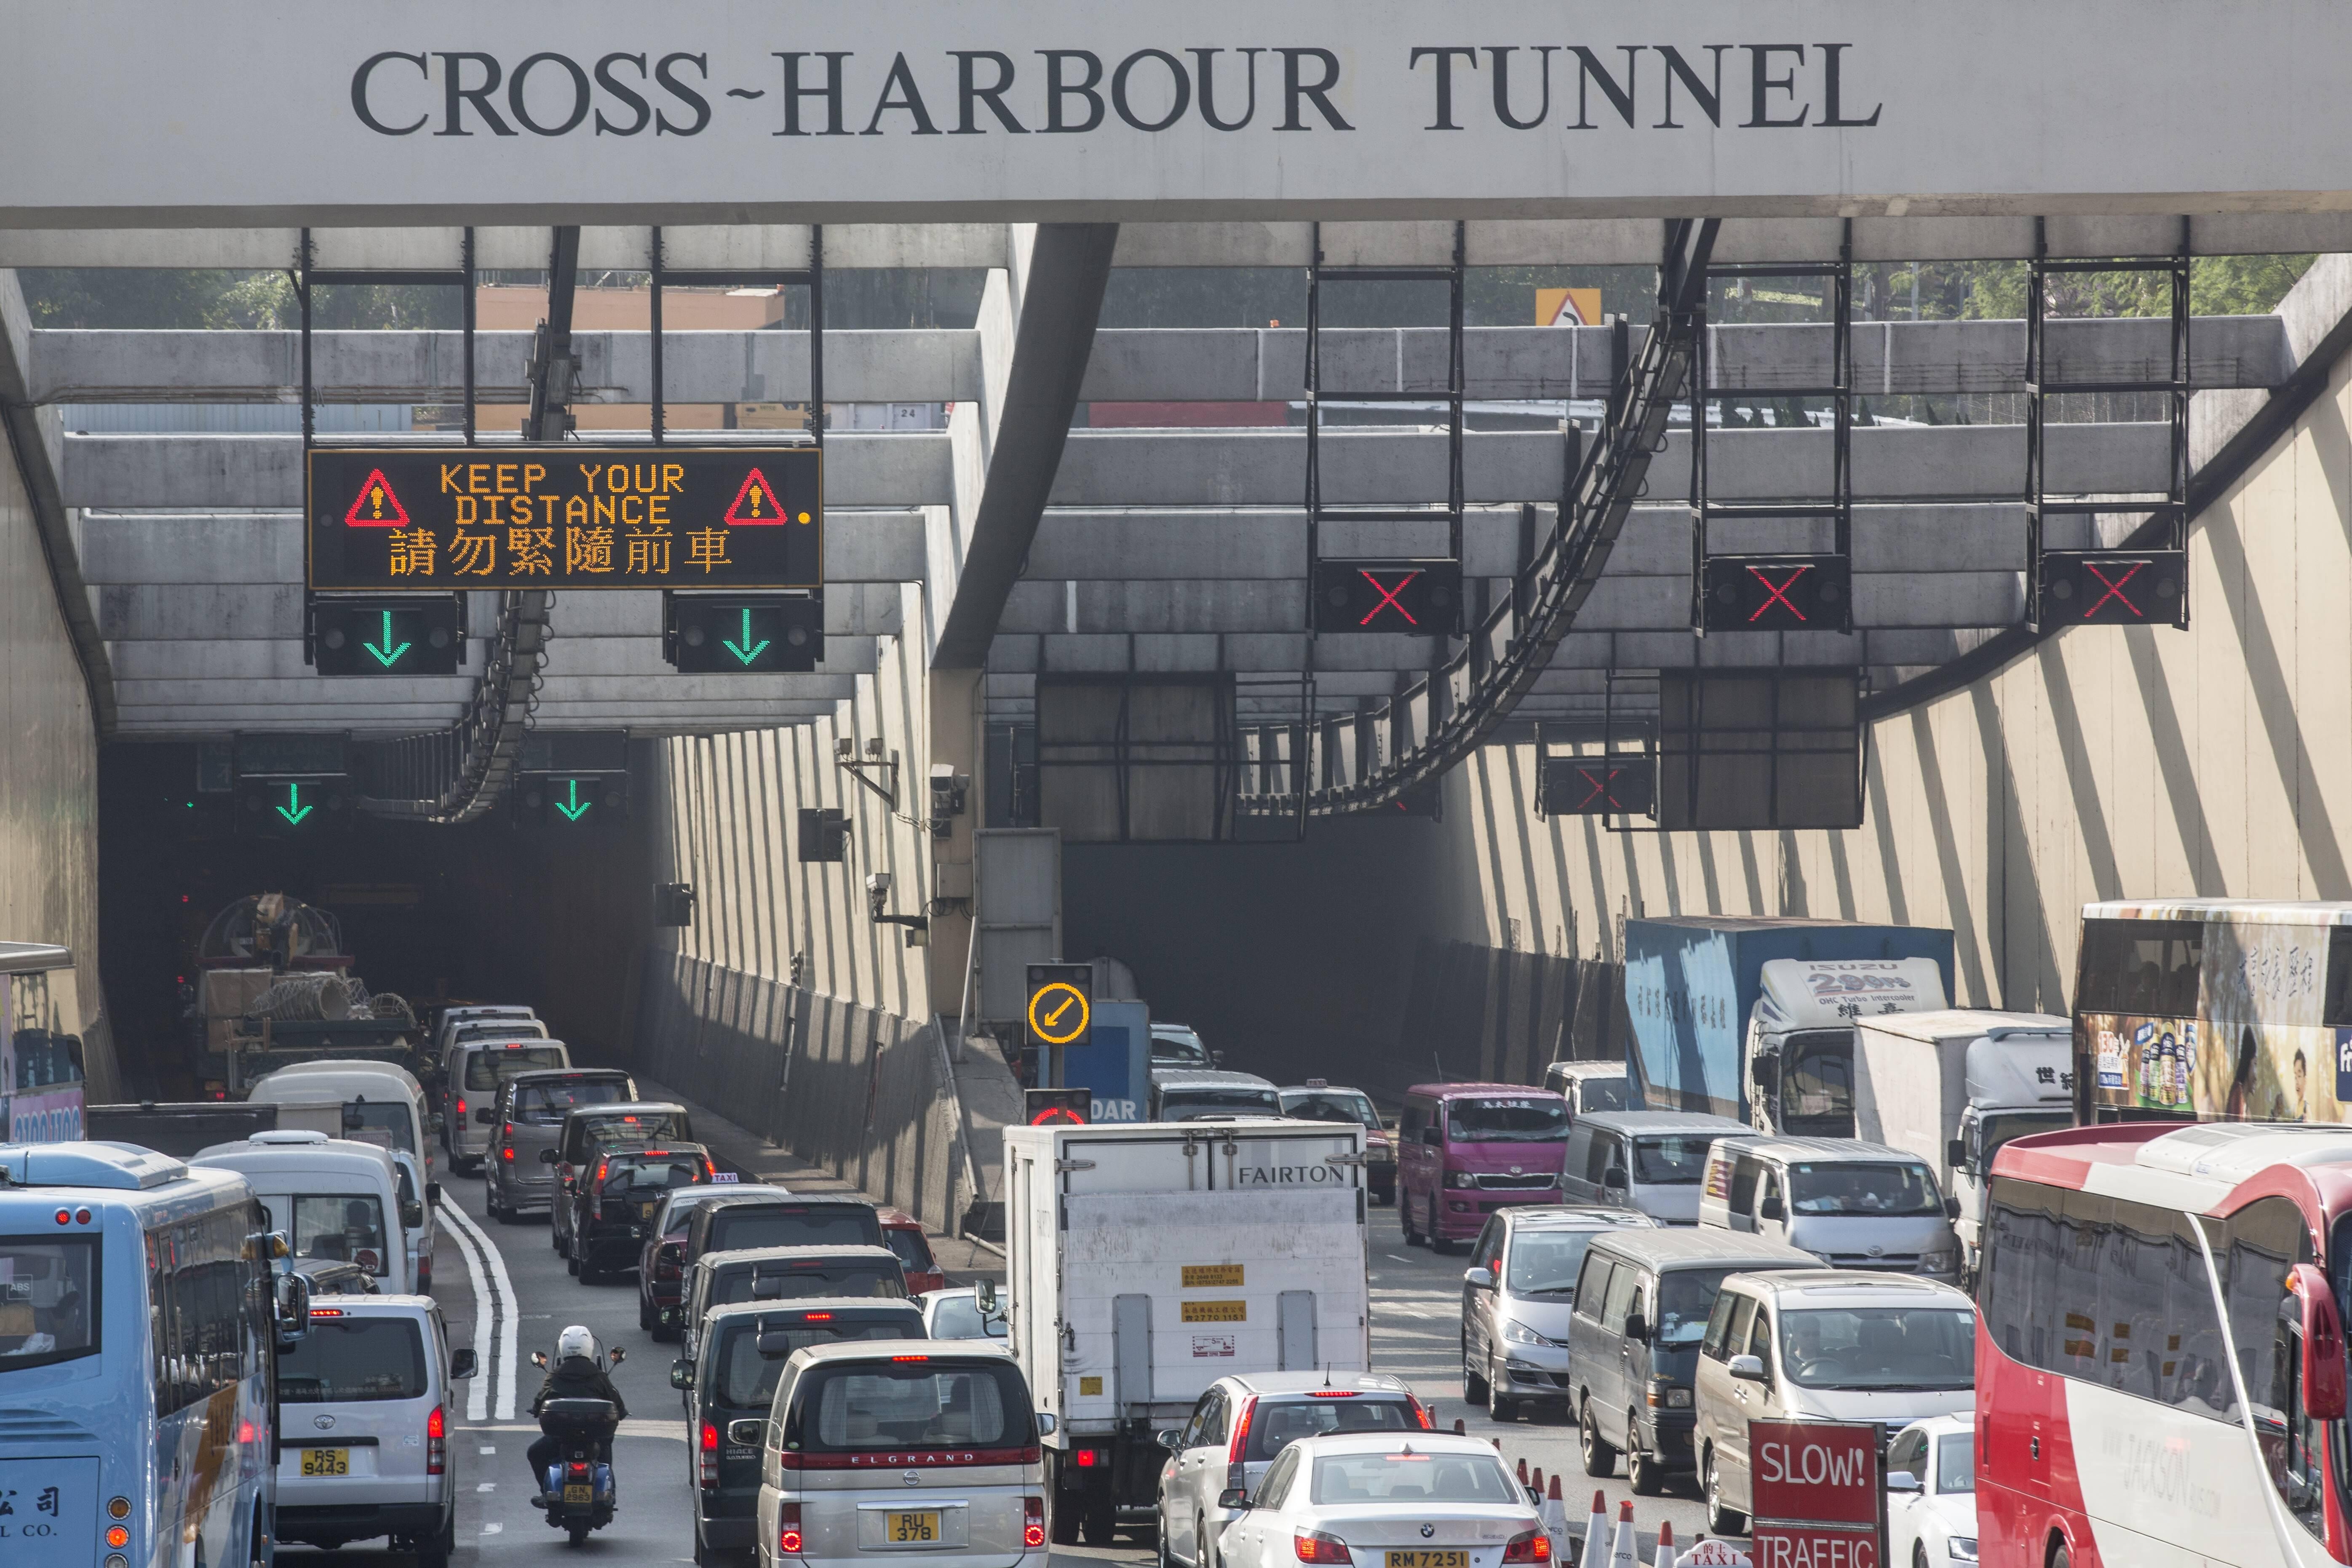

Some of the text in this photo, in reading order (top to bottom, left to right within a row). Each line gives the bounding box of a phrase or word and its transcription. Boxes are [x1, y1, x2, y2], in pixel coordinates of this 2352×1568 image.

[1409, 43, 1882, 130] TUNNEL
[901, 409, 915, 417] 24
[441, 464, 684, 493] KEEP YOUR
[455, 495, 670, 524] DISTANCE
[389, 526, 732, 575] 請勿緊隨前車
[1239, 1165, 1344, 1184] FAIRTON
[10, 1283, 30, 1292] ABS
[315, 1450, 335, 1462] RS
[852, 1454, 973, 1464] ELGRAND
[304, 1461, 346, 1475] 9443
[1761, 1442, 1865, 1486] SLOW!
[902, 1514, 924, 1528] RU
[22, 1524, 57, 1536] CO.
[897, 1527, 931, 1541] 378
[1704, 1544, 1726, 1554] 的士
[1758, 1536, 1874, 1568] TRAFFIC
[1391, 1552, 1464, 1567] RM 7251
[1692, 1554, 1737, 1565] TAXI
